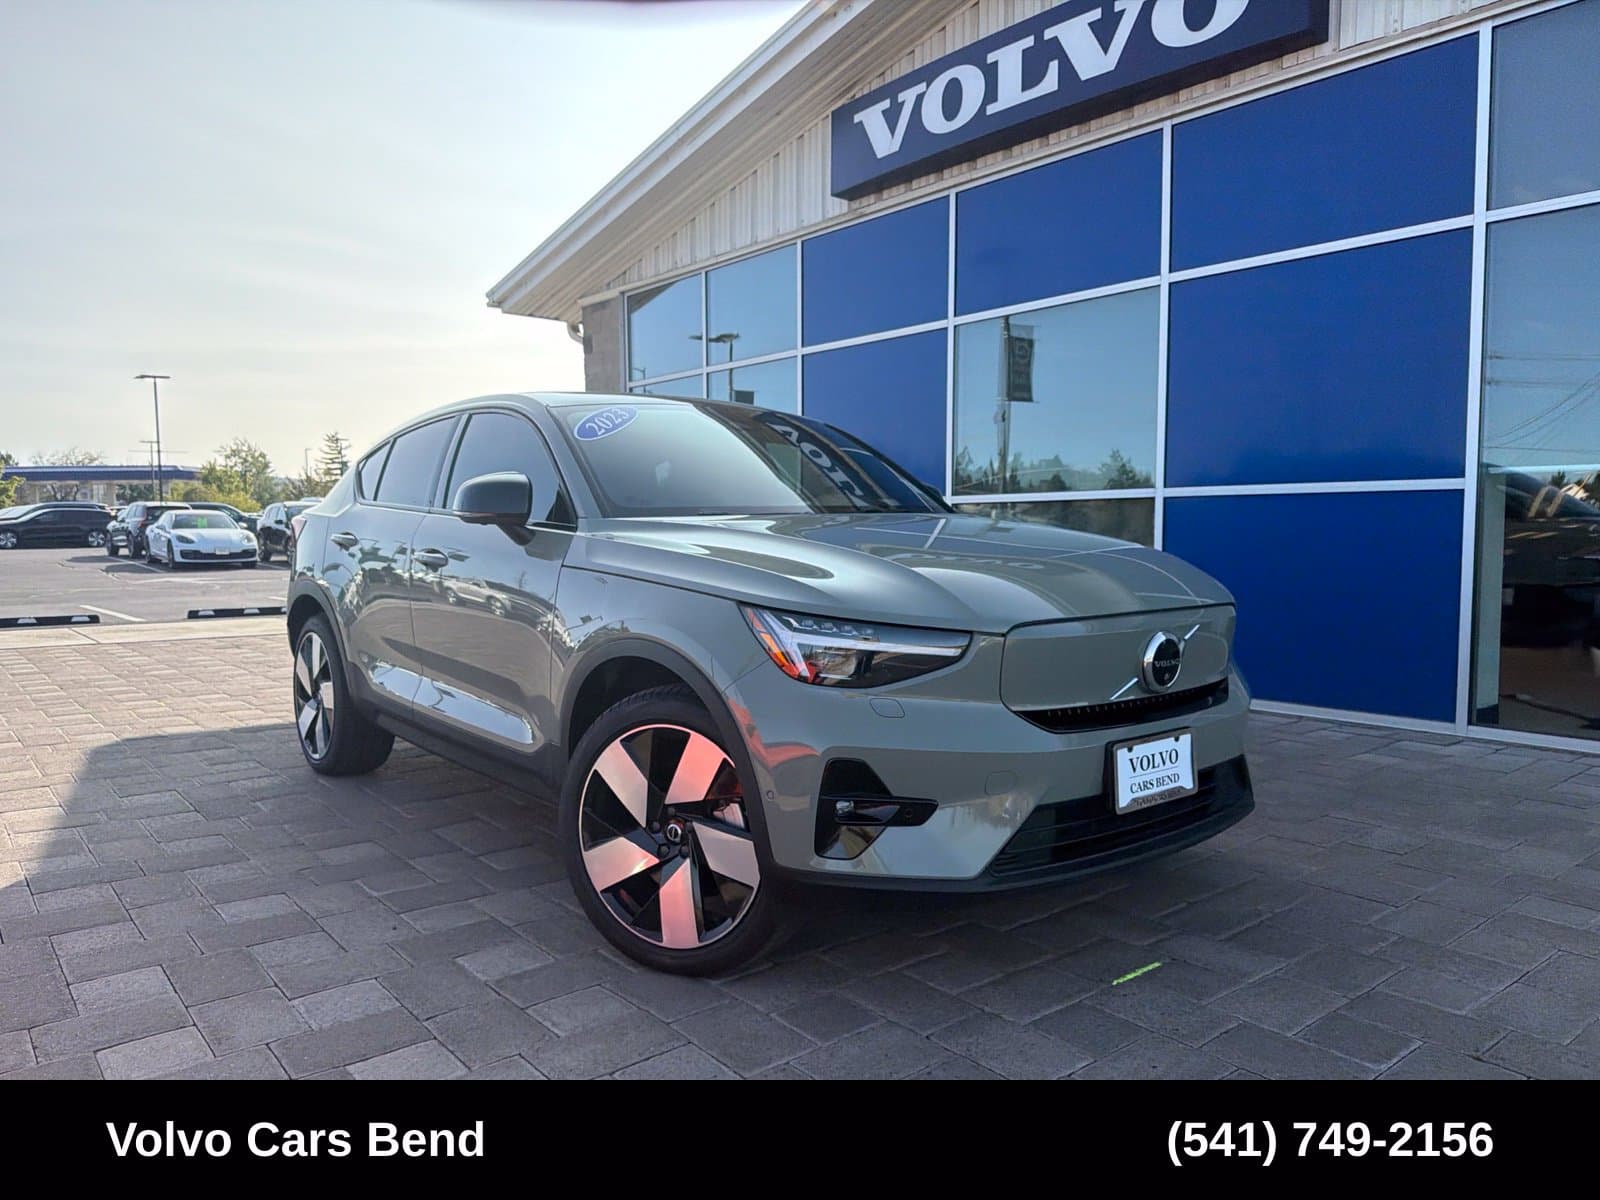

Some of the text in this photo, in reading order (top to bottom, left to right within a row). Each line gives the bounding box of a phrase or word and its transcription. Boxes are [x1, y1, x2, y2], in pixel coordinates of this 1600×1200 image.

[854, 0, 1249, 159] VOLVO
[585, 409, 629, 435] 2023
[1154, 658, 1180, 668] VOLVO
[1128, 748, 1179, 774] VOLVO
[1130, 773, 1180, 794] CARS BEND
